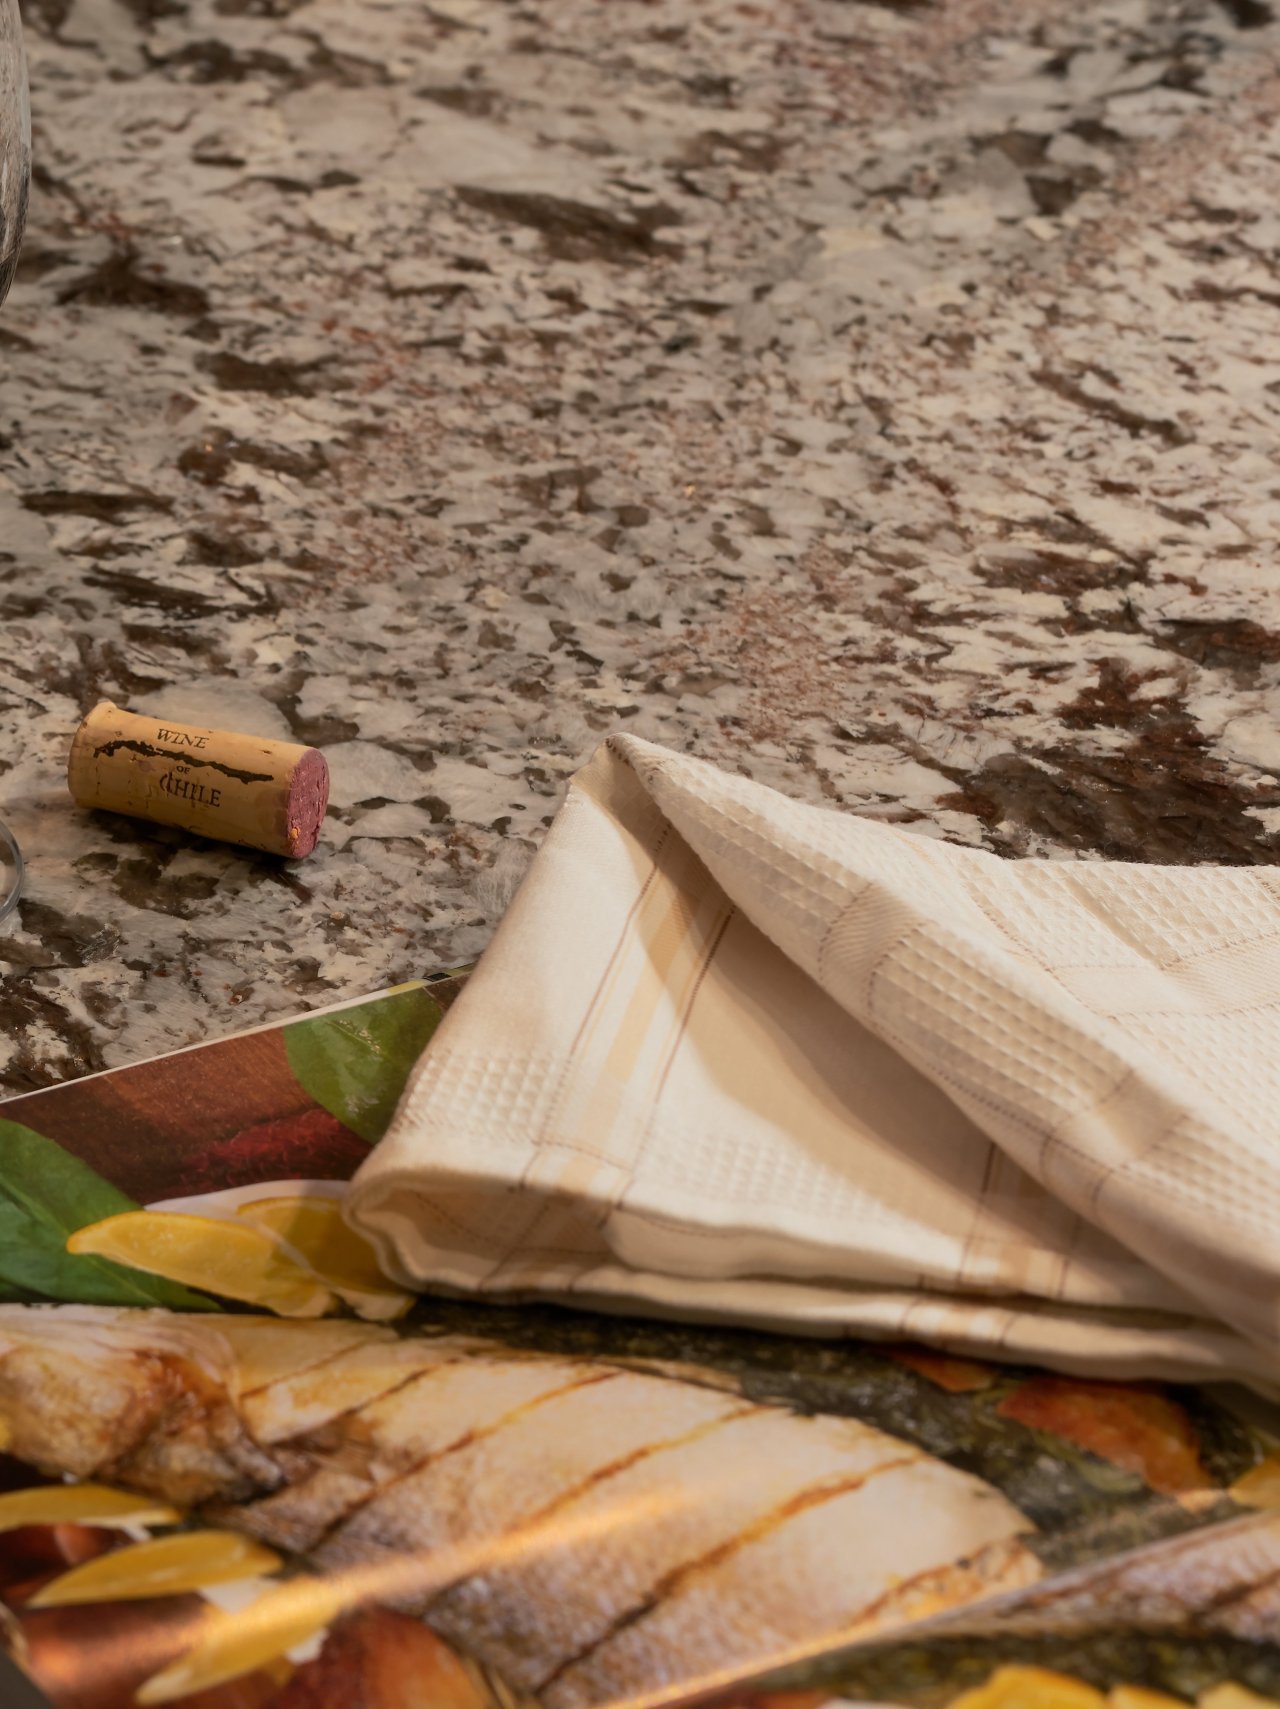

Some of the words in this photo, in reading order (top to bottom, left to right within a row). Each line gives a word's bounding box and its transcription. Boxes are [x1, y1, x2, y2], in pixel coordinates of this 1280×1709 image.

[156, 728, 210, 749] WINE
[176, 765, 191, 775] OF
[159, 770, 222, 809] CHILE
